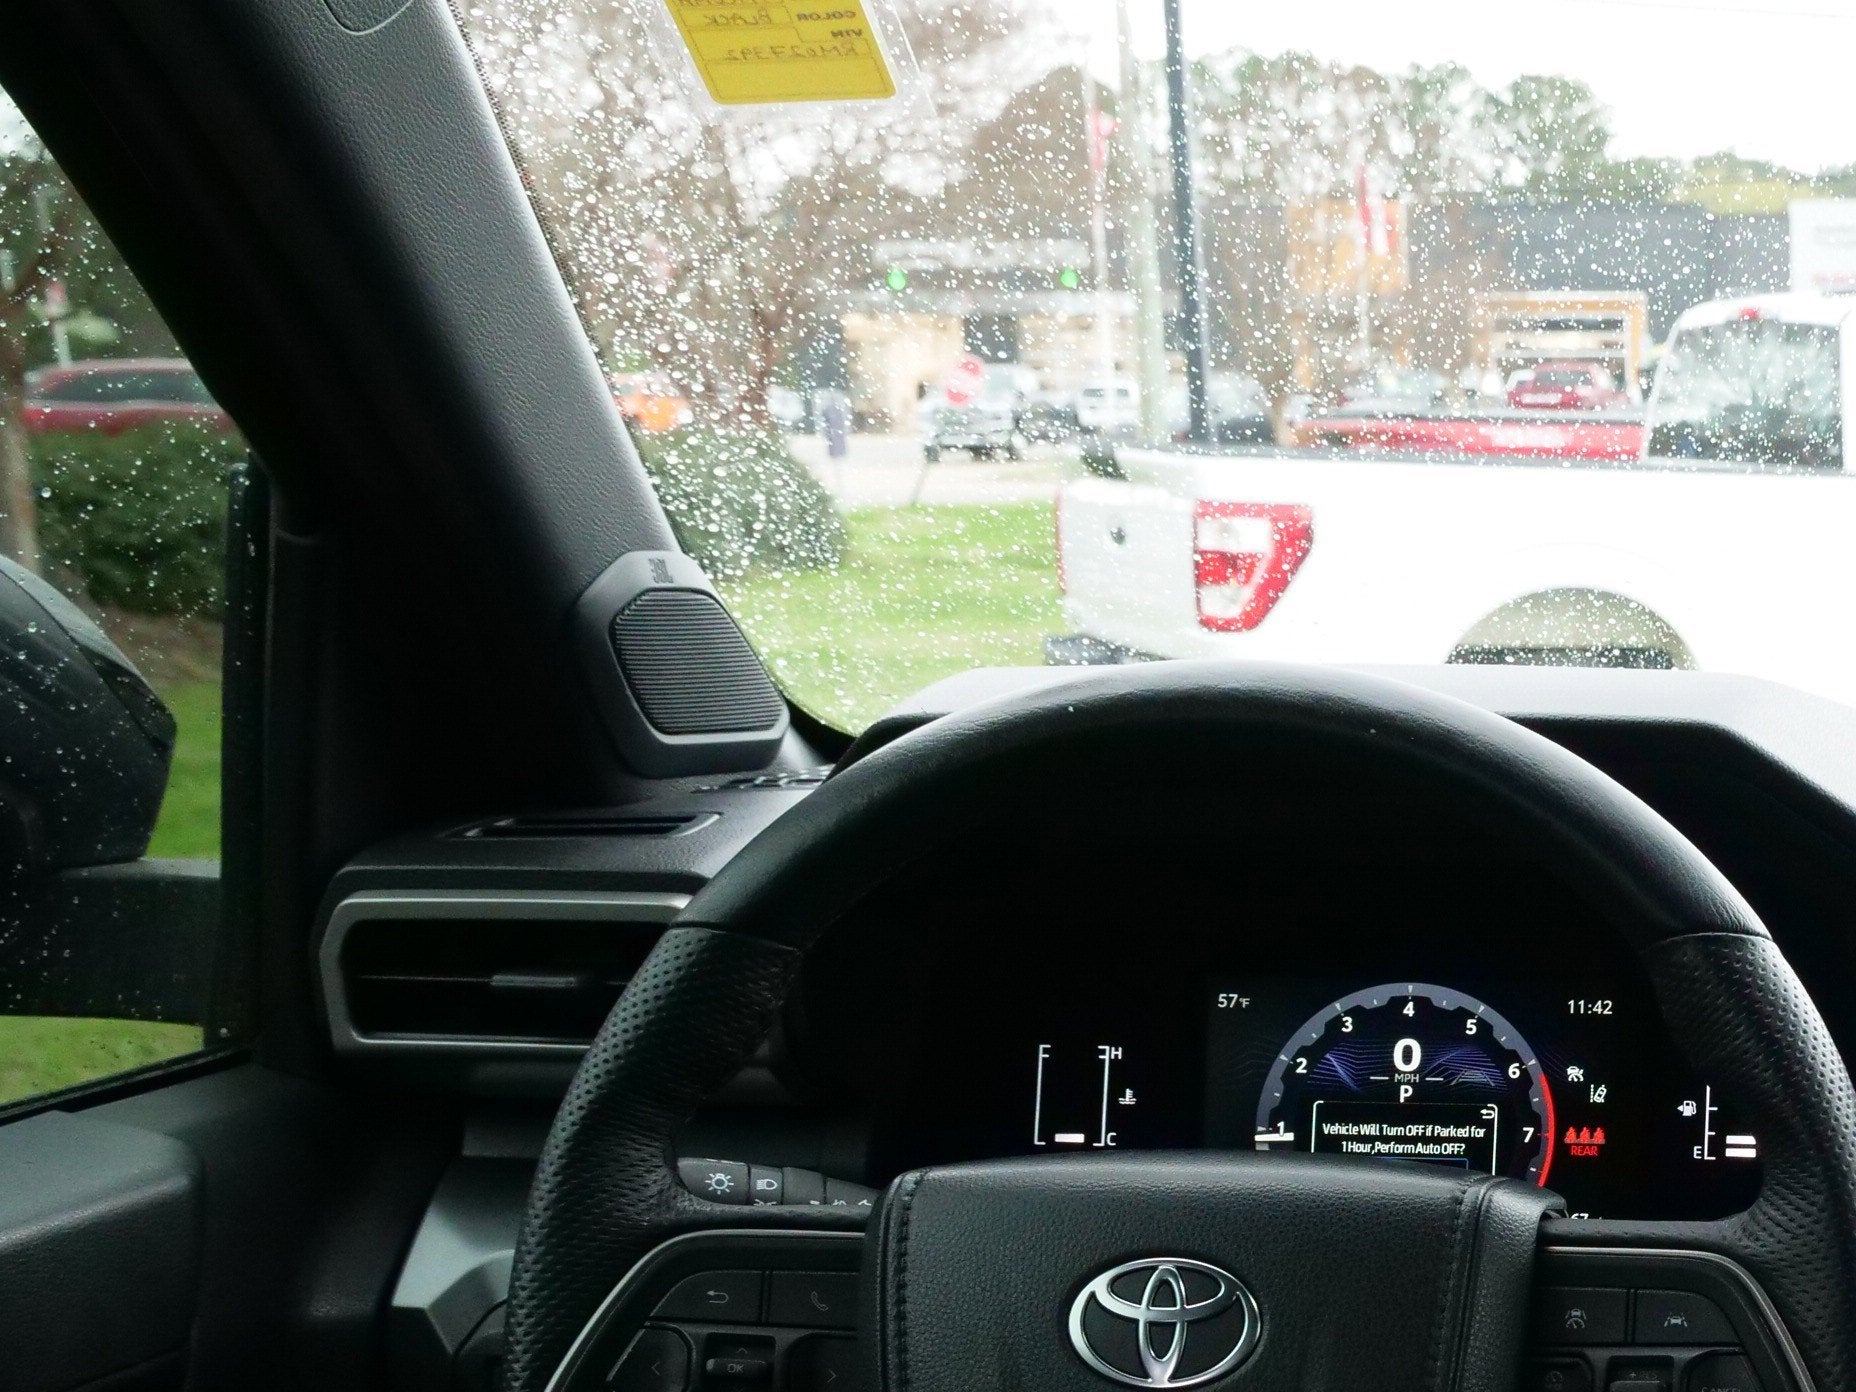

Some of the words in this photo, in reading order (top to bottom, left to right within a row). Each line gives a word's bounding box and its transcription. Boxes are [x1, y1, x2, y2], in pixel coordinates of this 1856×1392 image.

[1403, 1001, 1415, 1017] 4
[1567, 1000, 1613, 1015] 11:42
[1341, 1016, 1353, 1032] 3
[1465, 1019, 1477, 1035] 5
[1111, 1048, 1122, 1060] H
[1393, 1038, 1421, 1072] 0
[1295, 1058, 1307, 1073] 2
[1508, 1063, 1520, 1078] 6
[1394, 1073, 1420, 1083] MPH
[1399, 1085, 1413, 1103] P
[1322, 1123, 1358, 1136] Vehicle
[1360, 1124, 1380, 1136] Will
[1382, 1124, 1404, 1137] Turn
[1406, 1125, 1425, 1137] OFF
[1426, 1124, 1433, 1137] if
[1434, 1125, 1469, 1138] Parked
[1470, 1126, 1486, 1138] for
[1522, 1127, 1534, 1143] 7
[1107, 1133, 1117, 1146] C
[1416, 1143, 1440, 1155] Auto
[1442, 1143, 1465, 1155] OFF?
[1571, 1145, 1598, 1156] REAR
[1693, 1146, 1702, 1159] E
[727, 1363, 744, 1373] OK
